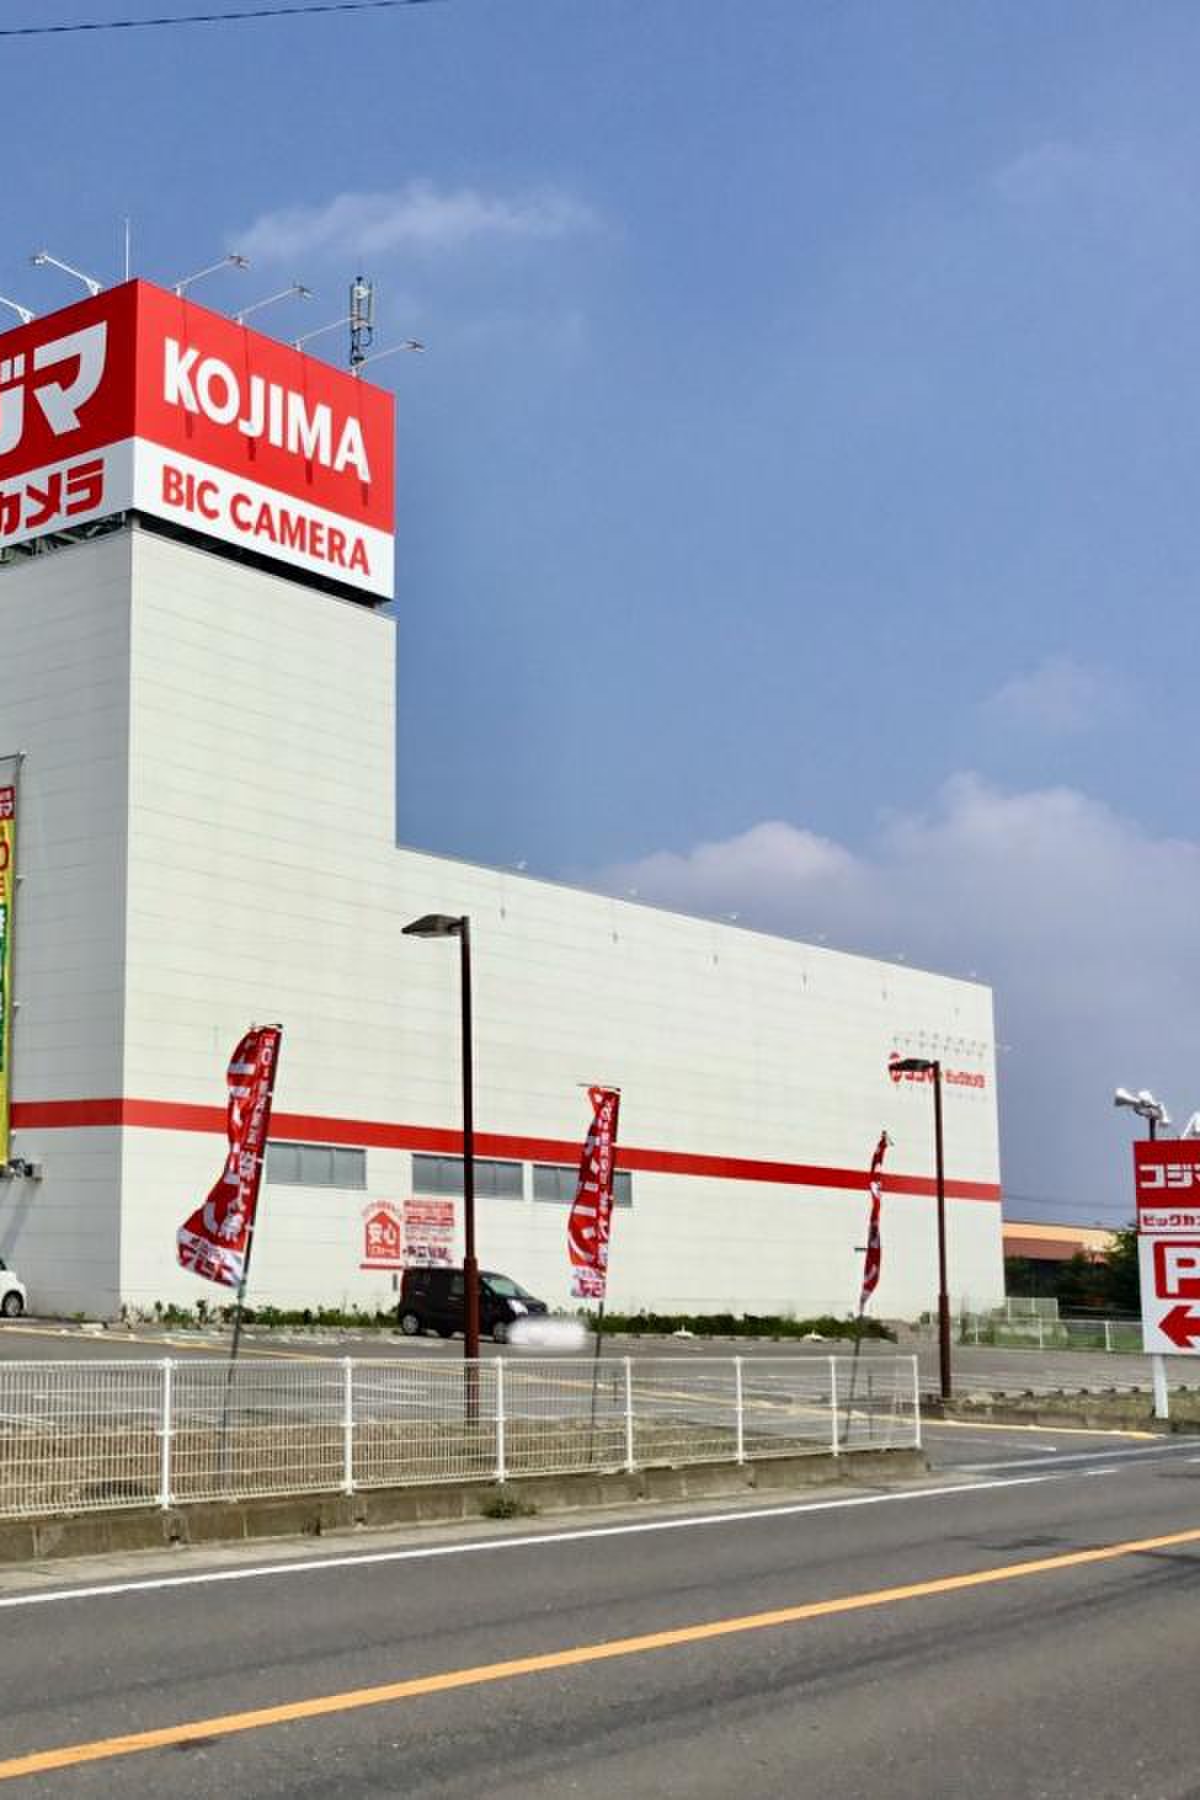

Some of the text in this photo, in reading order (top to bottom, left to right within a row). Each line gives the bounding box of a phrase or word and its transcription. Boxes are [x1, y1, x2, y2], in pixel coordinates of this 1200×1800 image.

[164, 336, 372, 484] KOJIMA
[162, 465, 371, 577] BIC CAMERA
[1164, 1246, 1200, 1294] P
